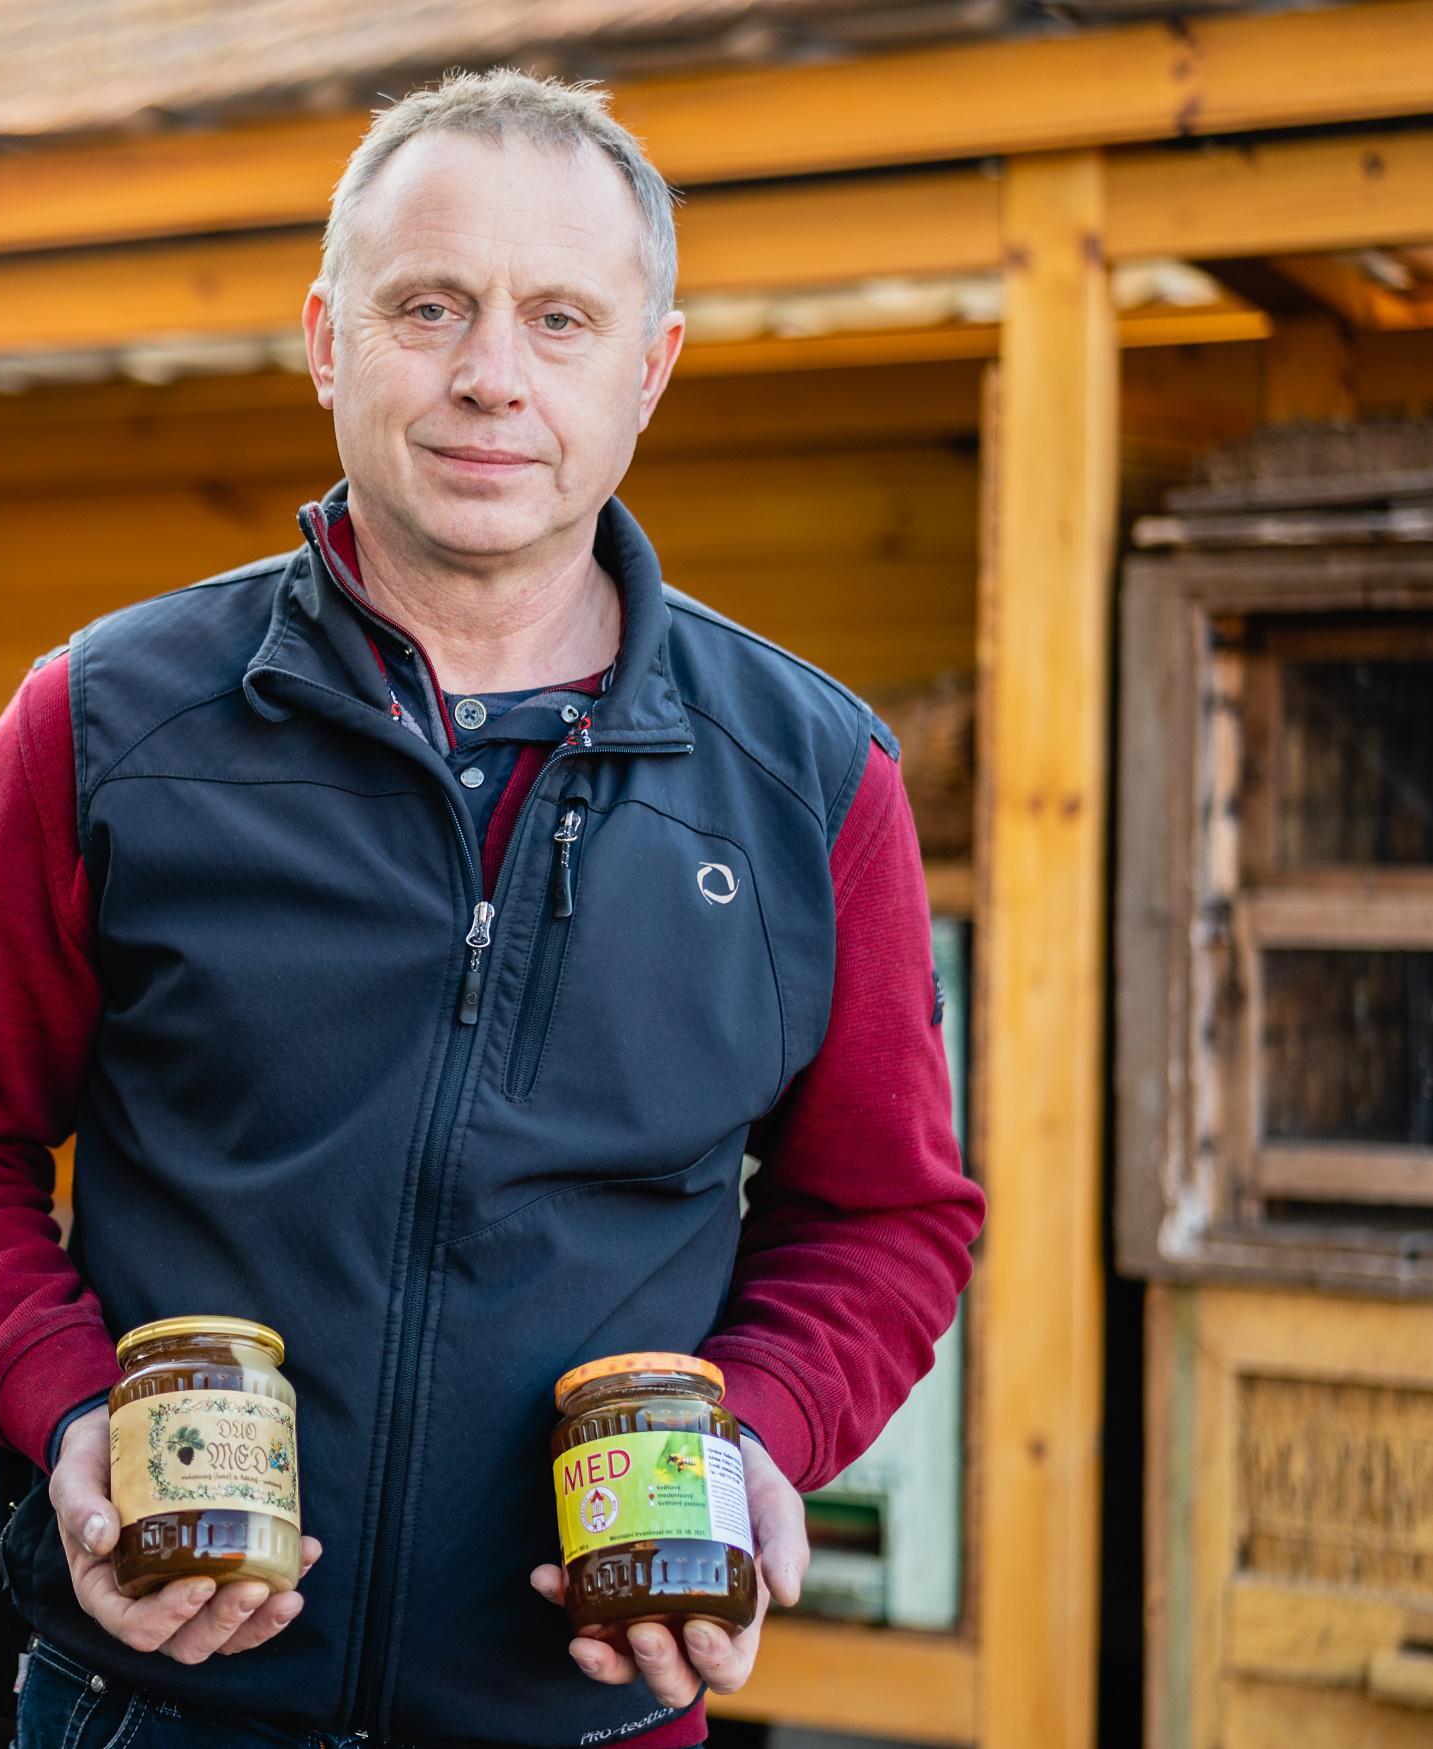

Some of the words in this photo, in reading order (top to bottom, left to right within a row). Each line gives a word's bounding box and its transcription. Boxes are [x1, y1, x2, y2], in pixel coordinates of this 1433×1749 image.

[216, 1419, 257, 1441] DUO
[207, 1442, 268, 1475] MED
[564, 1449, 631, 1496] MED
